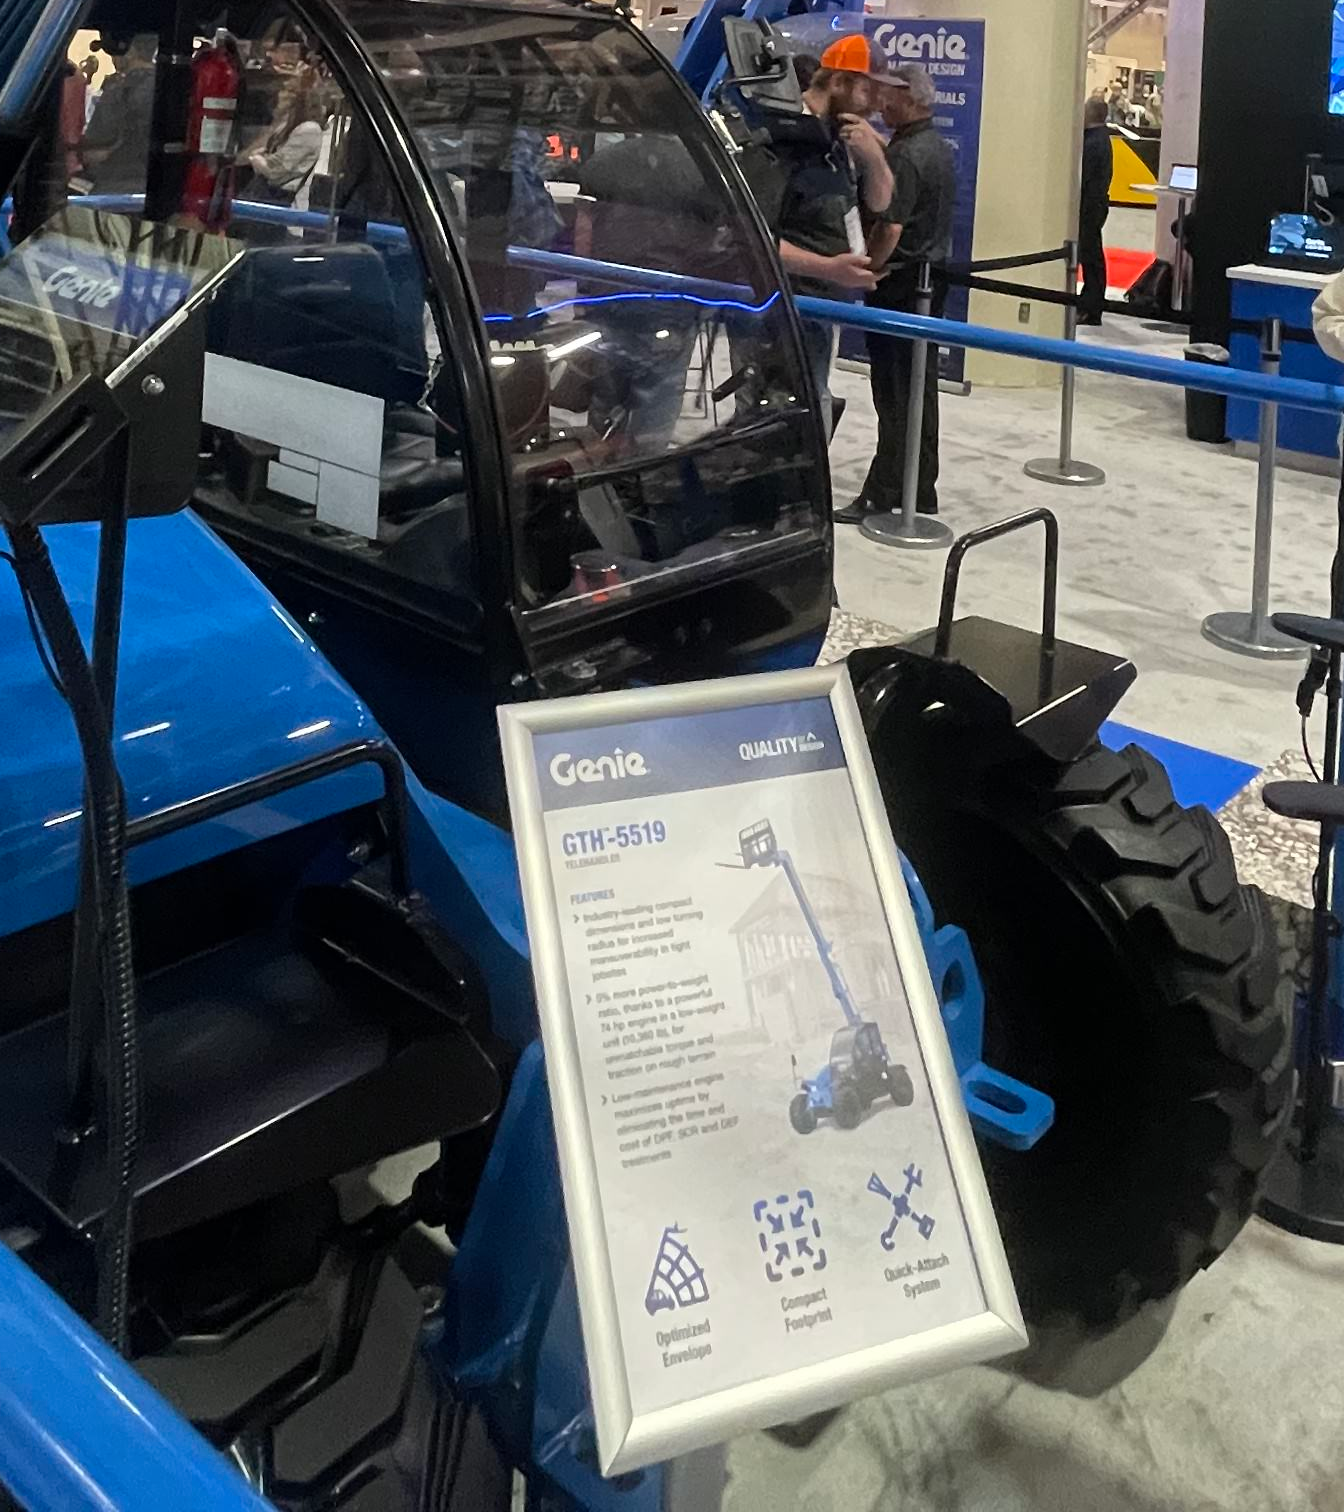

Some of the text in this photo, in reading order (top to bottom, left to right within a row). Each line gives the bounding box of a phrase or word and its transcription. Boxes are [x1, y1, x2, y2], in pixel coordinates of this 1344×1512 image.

[873, 23, 967, 60] Genie
[739, 737, 800, 759] QUALITY
[550, 749, 646, 785] Genie
[562, 820, 665, 855] GTH-5519
[570, 888, 614, 904] FEATURES
[884, 1253, 949, 1281] Quick-Attach
[780, 1287, 827, 1311] Compact
[903, 1278, 940, 1298] System
[656, 1318, 710, 1346] Optimized
[784, 1307, 832, 1332] Footprint
[662, 1343, 711, 1367] Envelope
